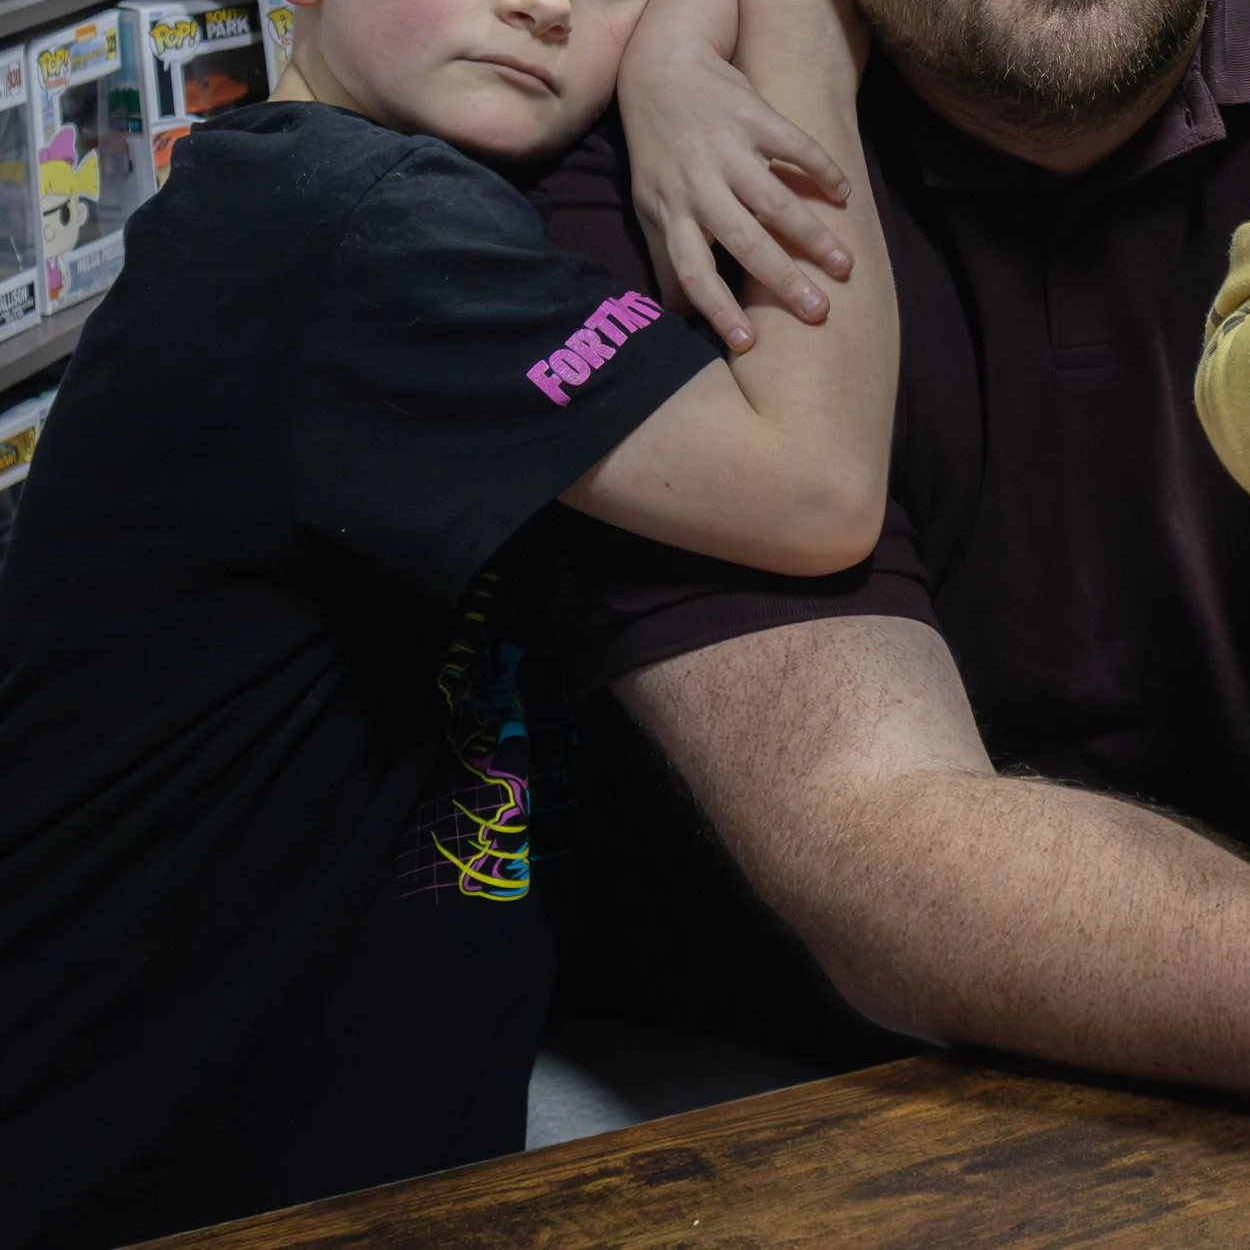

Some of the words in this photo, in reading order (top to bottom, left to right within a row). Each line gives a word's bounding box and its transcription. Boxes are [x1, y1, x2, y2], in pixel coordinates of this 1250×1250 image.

[150, 21, 198, 55] POP!
[207, 17, 249, 39] PARK
[38, 48, 70, 78] POP!
